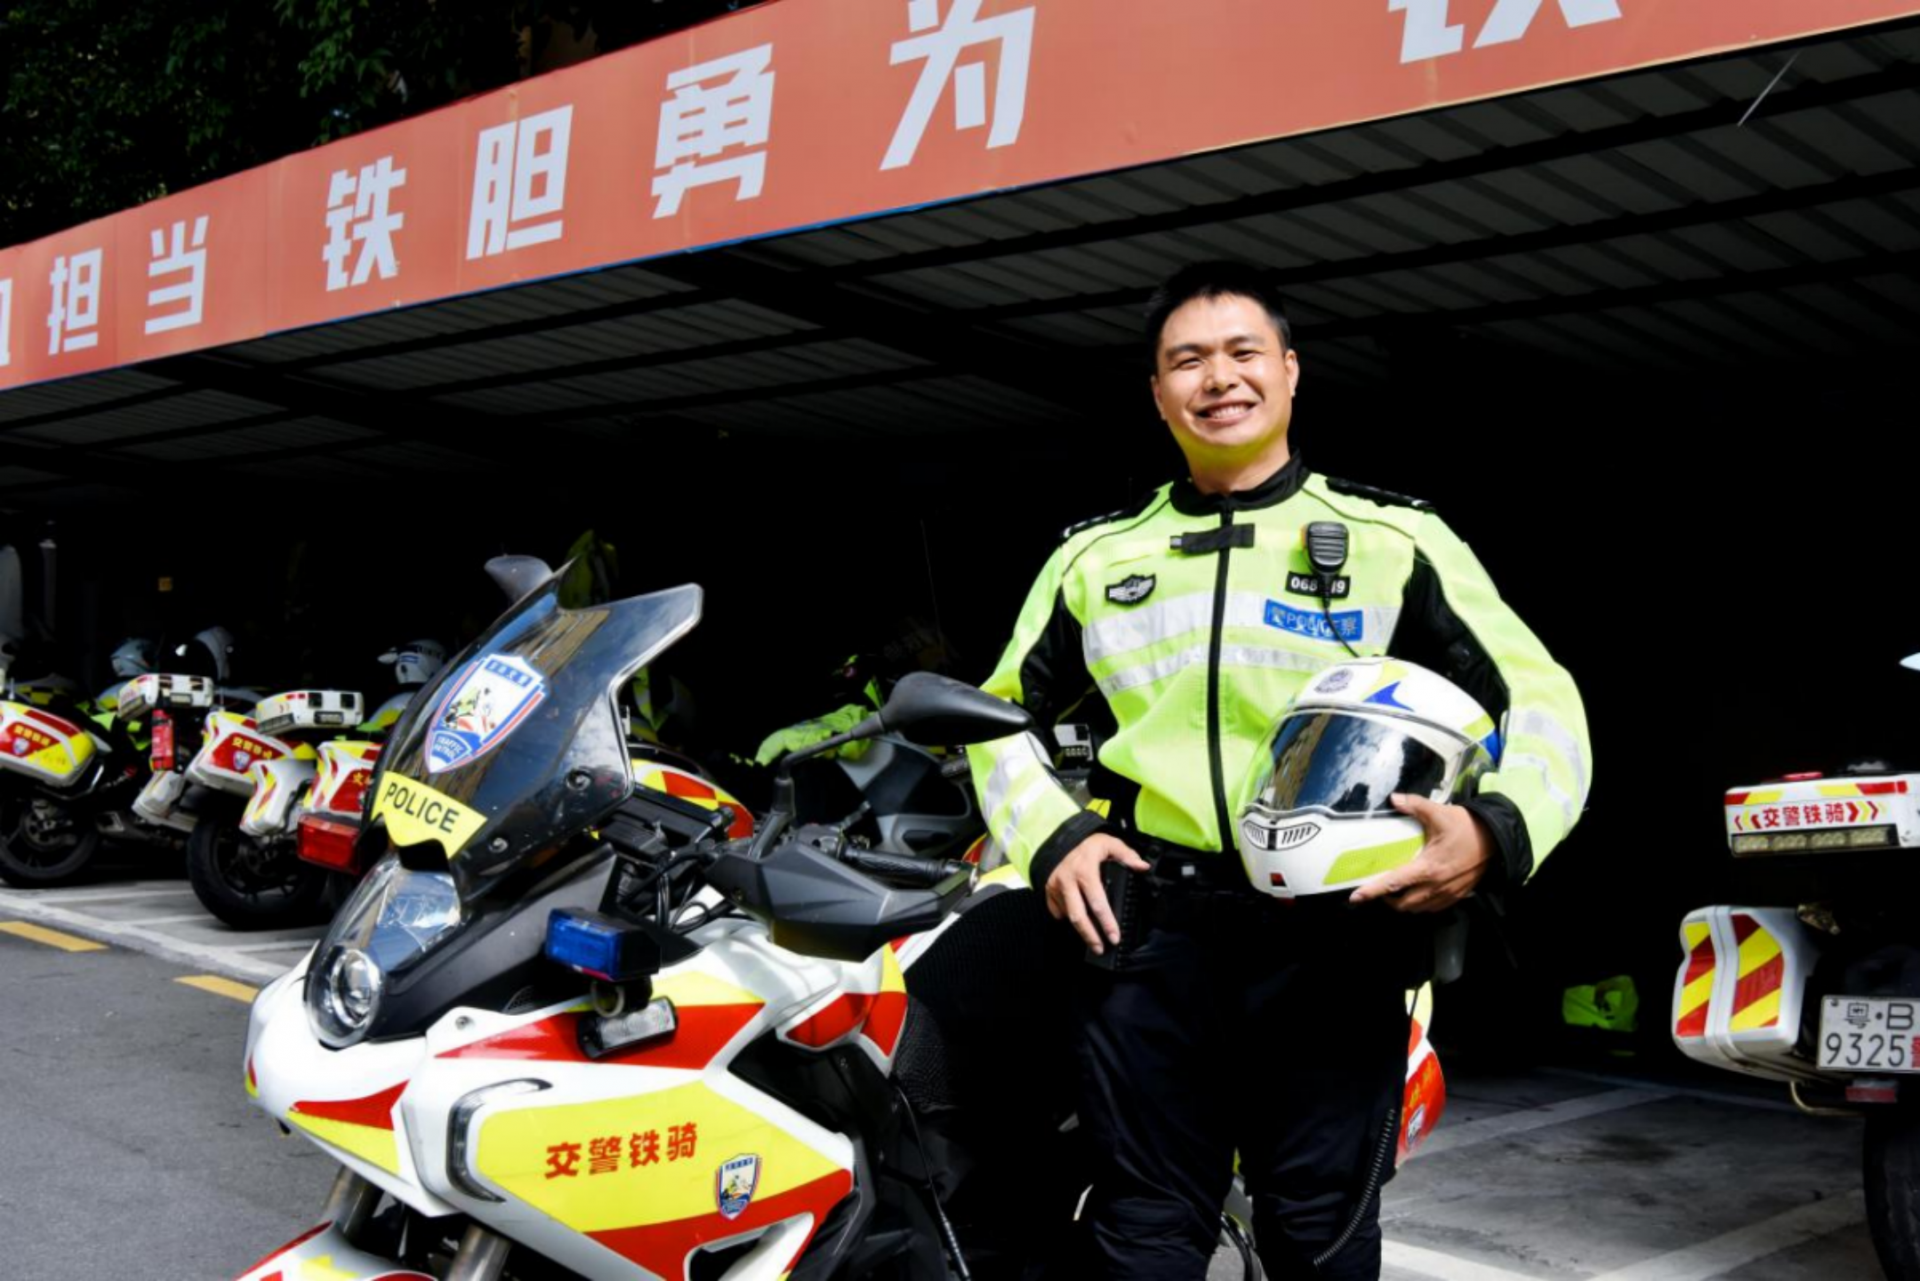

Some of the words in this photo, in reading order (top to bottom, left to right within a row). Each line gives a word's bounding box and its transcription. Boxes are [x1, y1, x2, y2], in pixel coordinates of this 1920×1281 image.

[0, 216, 208, 366] 担当
[322, 0, 1037, 292] 铁胆勇为
[383, 782, 460, 834] POLICE
[1762, 801, 1846, 828] 交警铁骑
[544, 1121, 698, 1180] 交警铁骑
